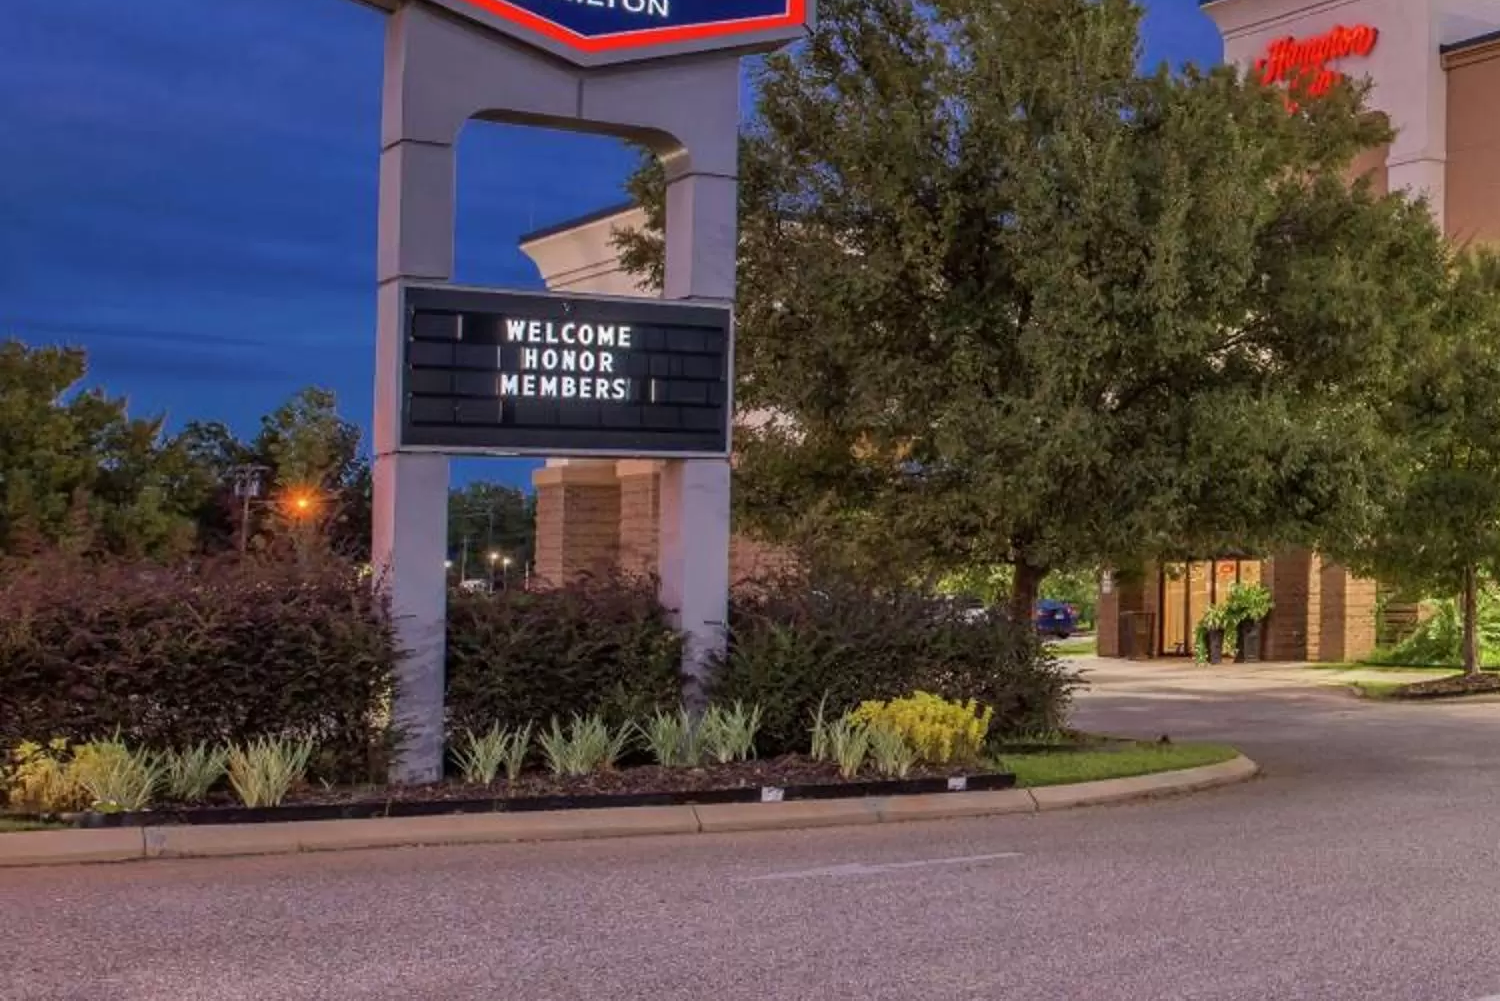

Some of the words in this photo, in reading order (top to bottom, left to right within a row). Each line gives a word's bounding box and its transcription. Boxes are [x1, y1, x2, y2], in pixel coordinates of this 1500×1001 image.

[506, 319, 632, 348] WELCOME
[522, 347, 613, 373] HONOR
[500, 373, 627, 400] MEMBERS
